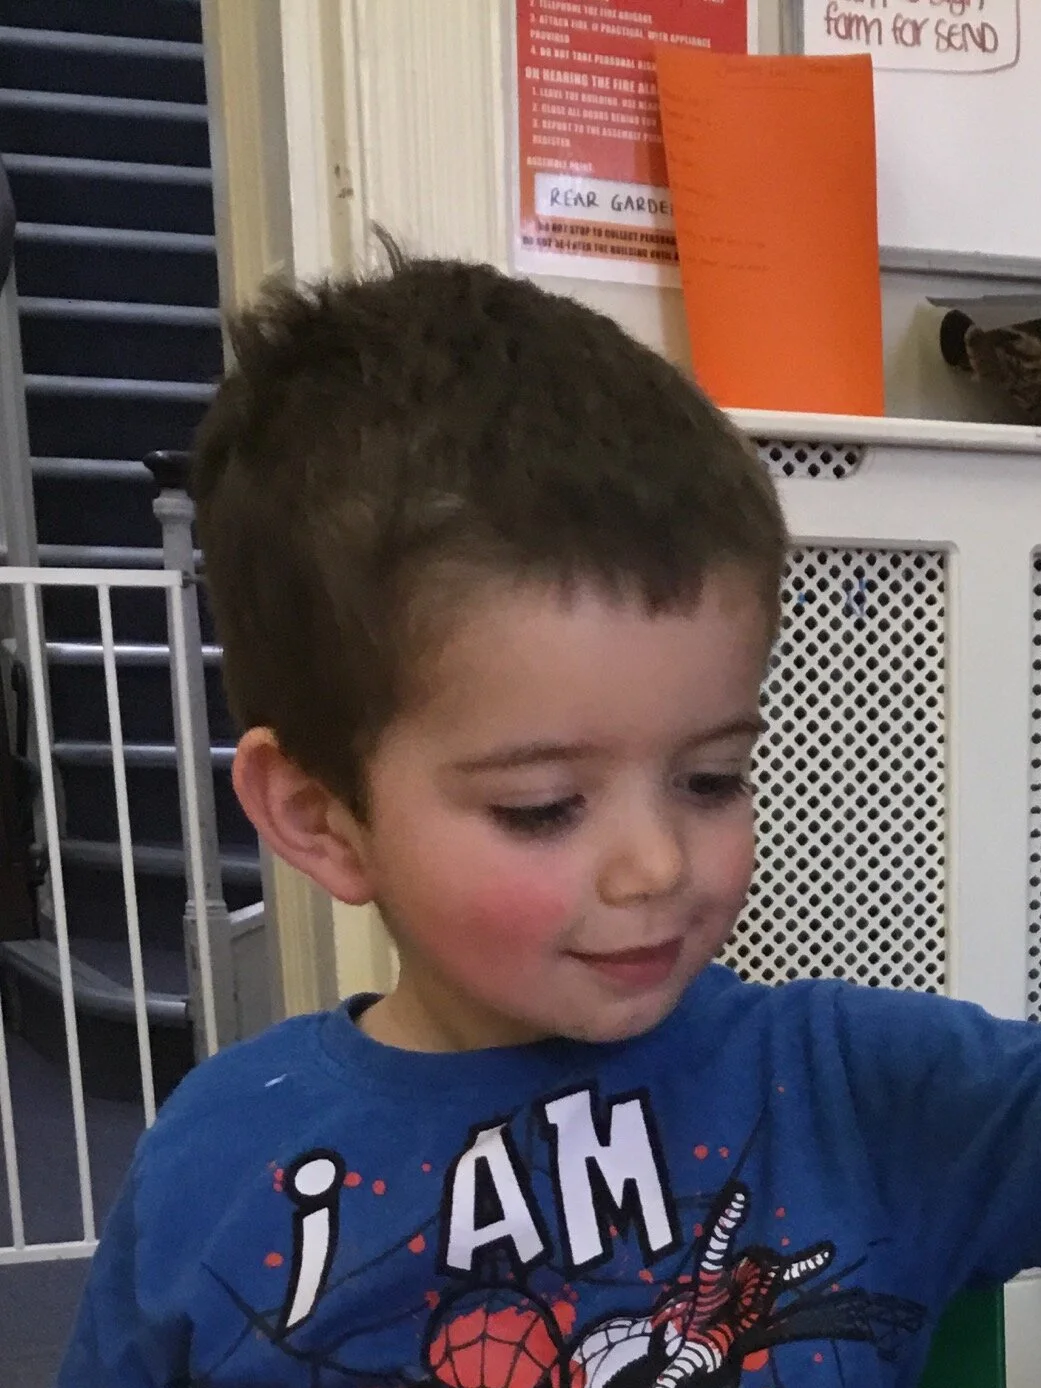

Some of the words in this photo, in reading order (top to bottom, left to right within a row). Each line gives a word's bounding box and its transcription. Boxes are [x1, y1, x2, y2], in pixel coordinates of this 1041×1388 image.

[539, 14, 568, 27] ATTACK
[540, 0, 581, 13] TELEPHONE
[584, 5, 598, 16] THE
[599, 8, 617, 18] FIRE
[618, 11, 652, 24] BRIGADE
[529, 29, 570, 44] PROVIDED
[934, 17, 999, 54] SEND
[540, 46, 551, 57] DO
[554, 48, 569, 59] NOT
[571, 50, 591, 63] TAKE
[594, 54, 635, 69] PERSONAL
[525, 66, 539, 80] ON
[542, 67, 588, 87] HEARING
[591, 75, 610, 89] THE
[613, 77, 635, 93] FIRE
[539, 87, 563, 99] LEAVE
[565, 90, 579, 101] THE
[622, 98, 636, 109] USE
[541, 103, 565, 115] CLOSE
[568, 106, 581, 117] ALL
[582, 109, 609, 121] DOORS
[611, 111, 639, 125] BEHIND
[542, 118, 571, 132] REPORT
[574, 123, 584, 133] TO
[587, 125, 600, 136] THE
[602, 127, 641, 141] ASSEMBLY
[526, 155, 567, 168] ASSEMBLY
[550, 186, 601, 208] REAR
[552, 222, 568, 233] NOT
[569, 224, 590, 237] STOP
[593, 226, 602, 238] TO
[604, 229, 638, 242] COLLECT
[594, 243, 608, 254] THE
[610, 245, 648, 258] BUILDING
[650, 249, 672, 261] UNTIL
[444, 1087, 678, 1273] AM
